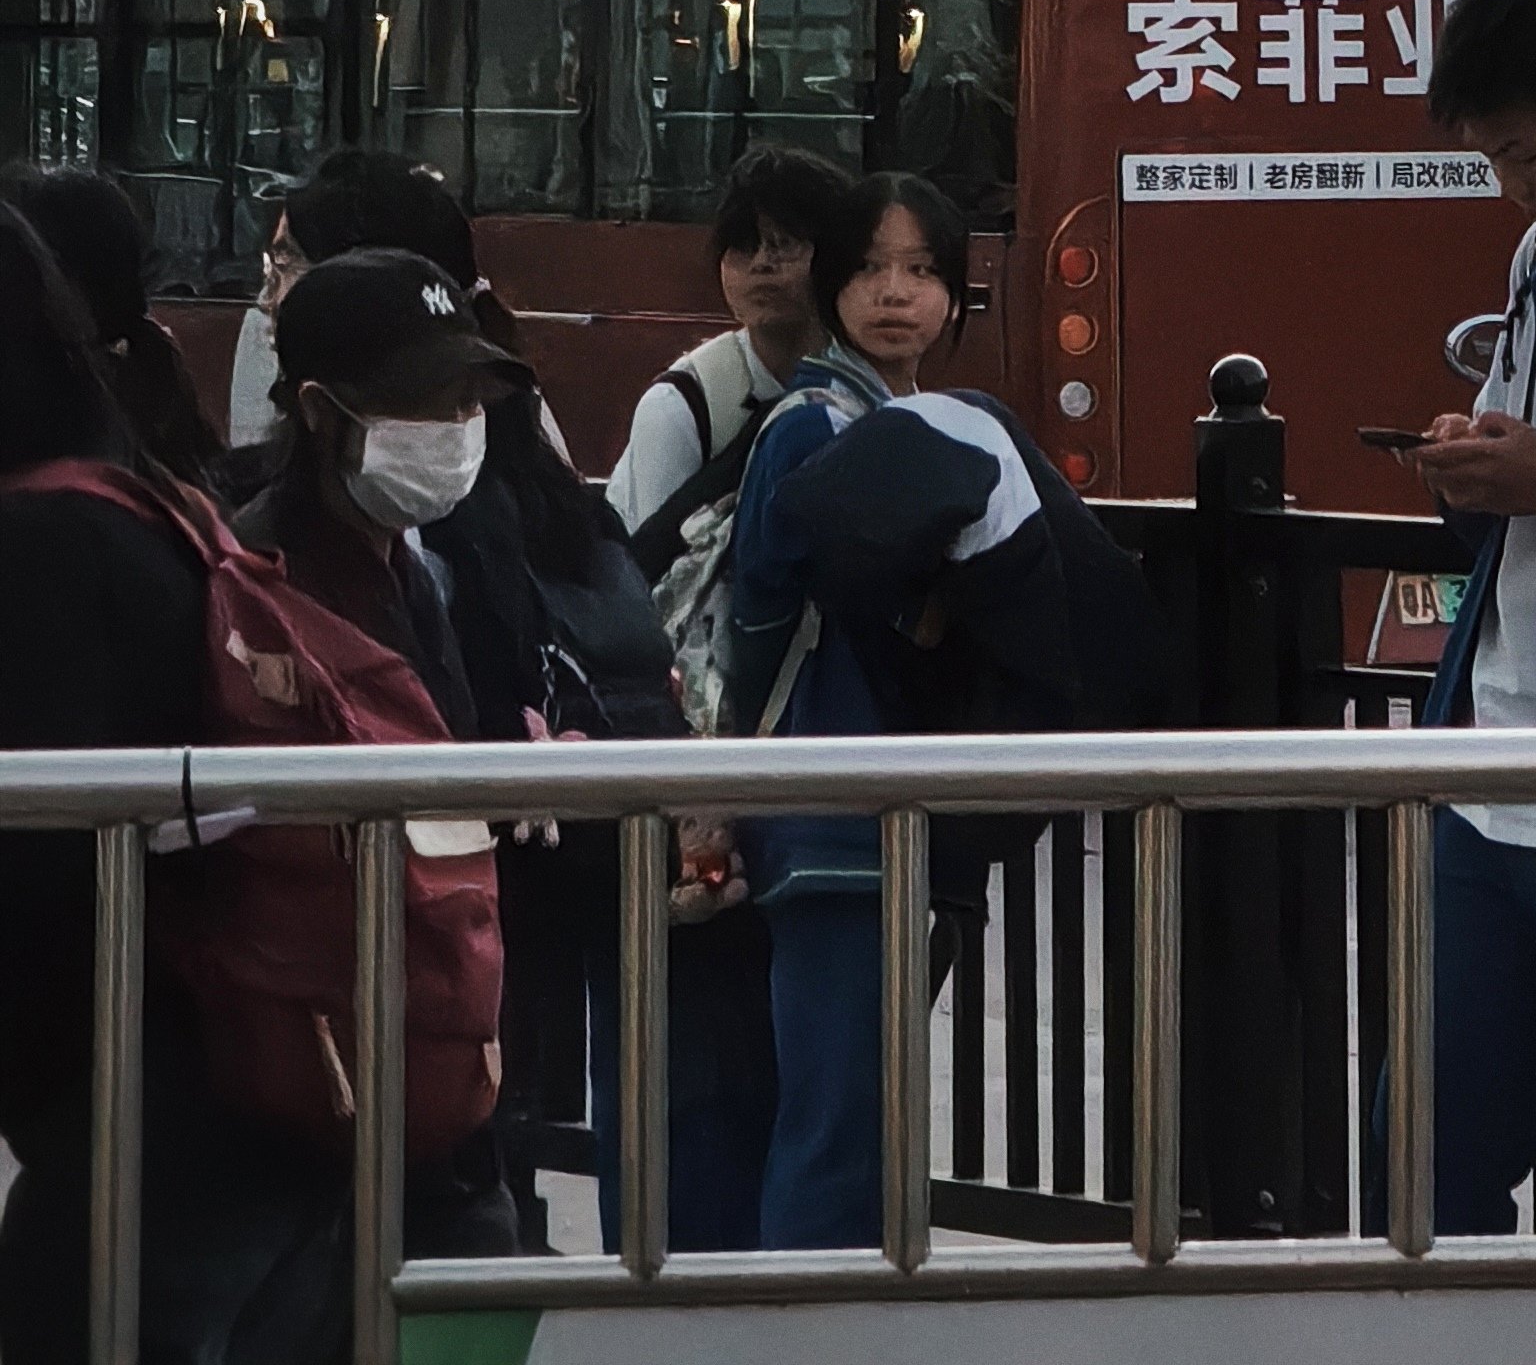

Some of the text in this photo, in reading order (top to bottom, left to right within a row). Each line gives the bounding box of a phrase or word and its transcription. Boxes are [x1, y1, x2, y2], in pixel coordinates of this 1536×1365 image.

[1135, 161, 1490, 191] 整家定制 老房翻新 局改微改
